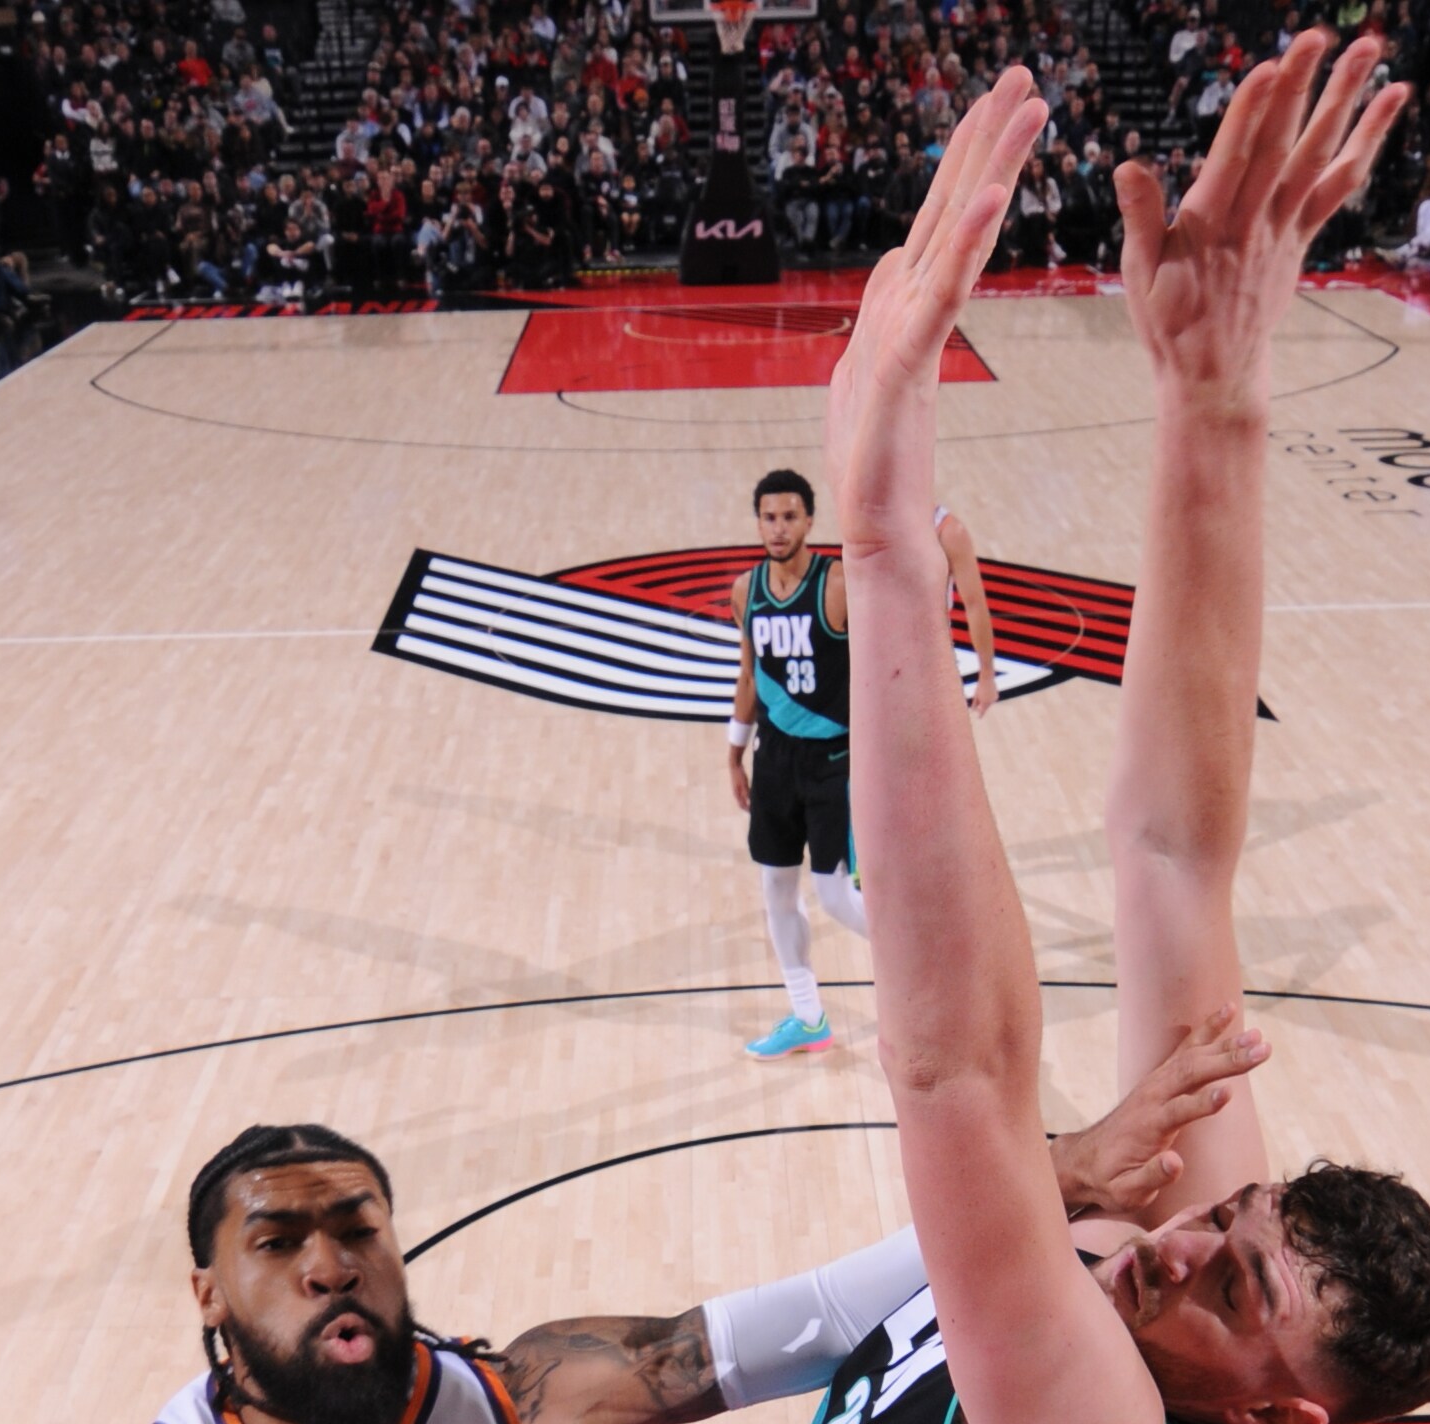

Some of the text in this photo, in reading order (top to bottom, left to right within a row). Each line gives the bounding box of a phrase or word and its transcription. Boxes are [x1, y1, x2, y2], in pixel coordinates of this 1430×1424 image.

[1268, 429, 1422, 516] center
[752, 614, 814, 657] PDX
[786, 659, 816, 694] 33
